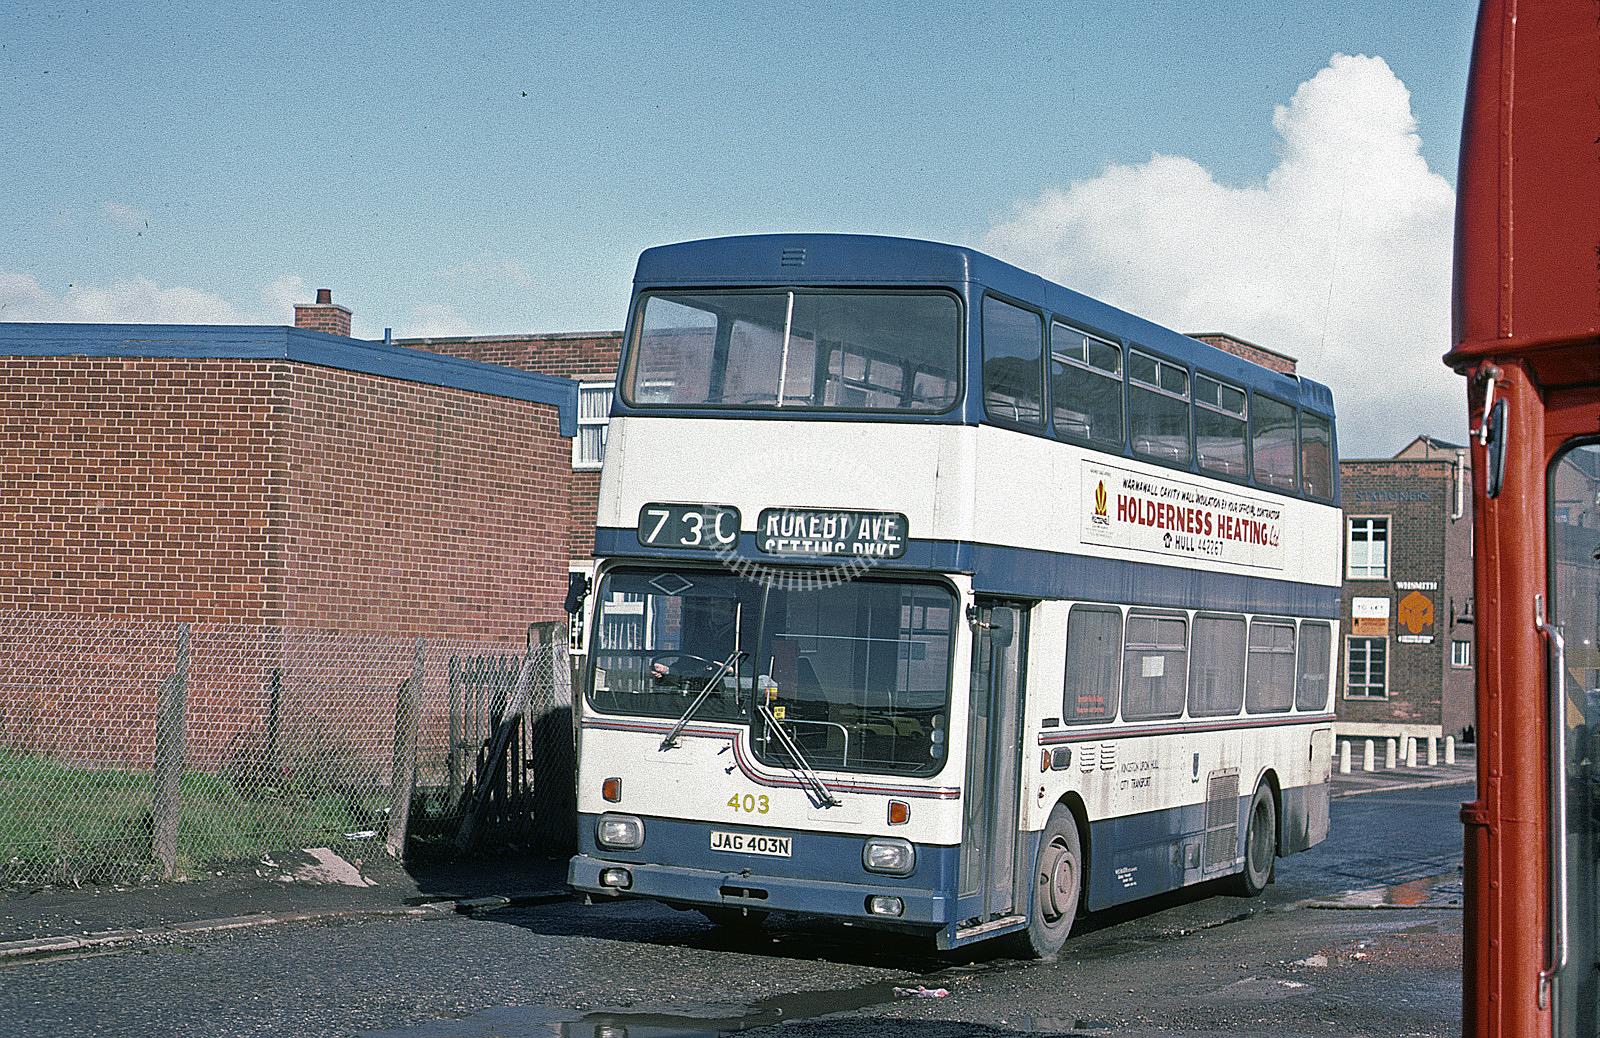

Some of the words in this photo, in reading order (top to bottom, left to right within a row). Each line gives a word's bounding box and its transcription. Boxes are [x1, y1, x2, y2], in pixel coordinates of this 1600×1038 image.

[1181, 491, 1195, 504] WALL
[1117, 494, 1212, 537] HOLDERNESS
[1217, 514, 1268, 546] HEATING
[1175, 535, 1195, 551] HULL
[727, 793, 769, 814] 403
[712, 833, 743, 850] JAG
[747, 837, 790, 854] 403N
